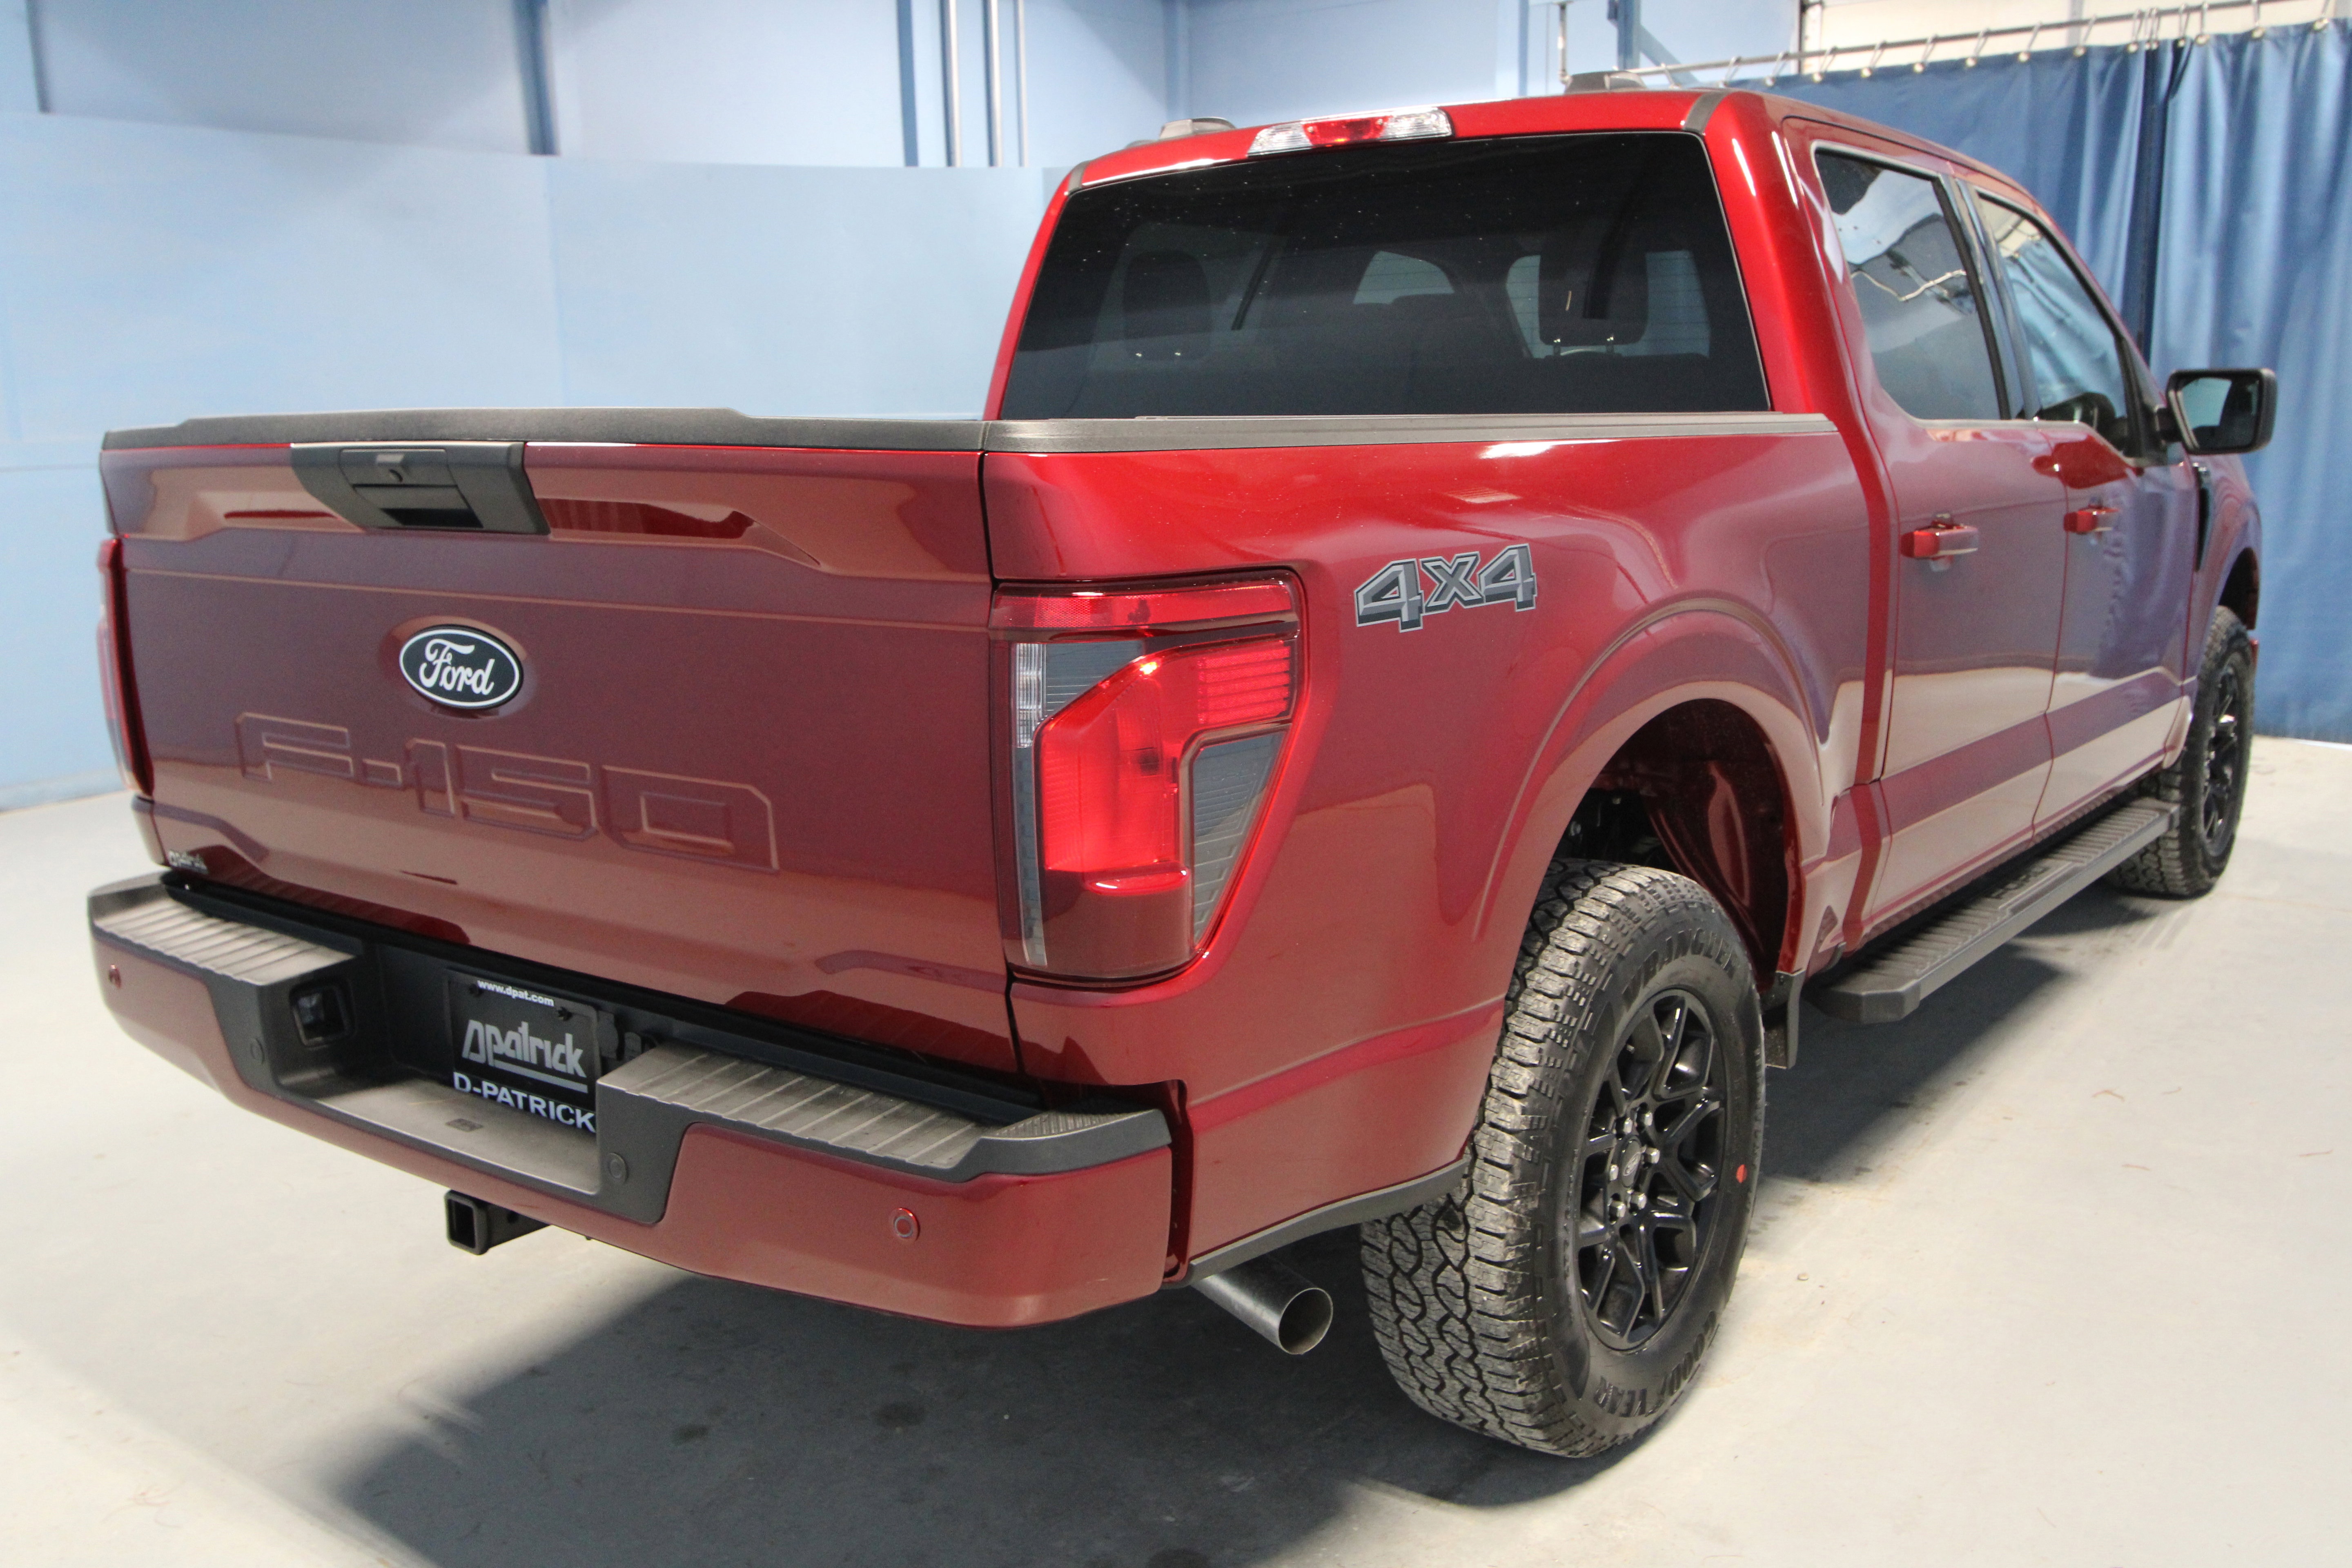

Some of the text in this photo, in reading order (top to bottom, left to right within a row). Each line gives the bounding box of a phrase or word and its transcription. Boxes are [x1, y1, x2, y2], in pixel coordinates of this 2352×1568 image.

[419, 638, 495, 695] Ford
[234, 711, 779, 875] F-150
[477, 980, 555, 1007] www.dpat.com
[452, 1071, 596, 1134] D-PATRICK
